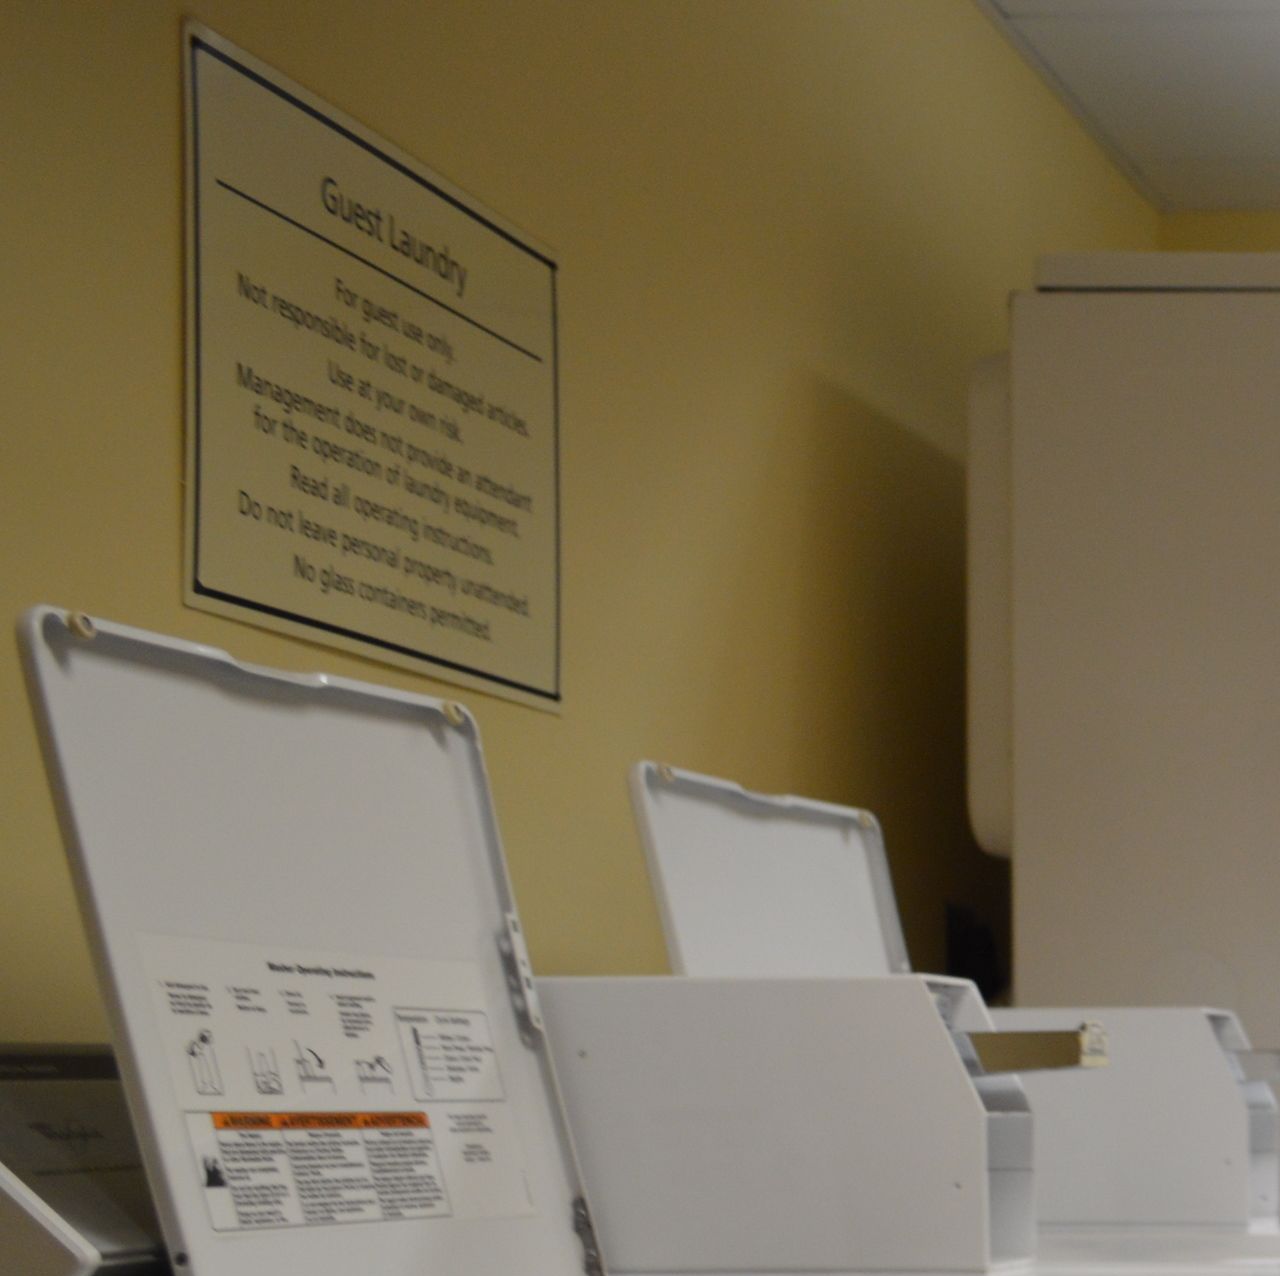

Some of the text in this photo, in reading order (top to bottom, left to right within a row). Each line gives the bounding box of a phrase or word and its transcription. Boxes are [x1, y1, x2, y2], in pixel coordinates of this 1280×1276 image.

[320, 175, 468, 298] Guest Laundry
[237, 271, 268, 309] Not
[271, 292, 356, 352] responsible
[359, 330, 380, 361] for
[384, 343, 408, 378] lost
[410, 363, 425, 383] or
[427, 367, 485, 416] damaged
[335, 277, 359, 309] For
[362, 297, 399, 334] guest
[402, 320, 424, 347] use
[236, 360, 533, 514] Management does not provide an attendant
[327, 357, 354, 393] Use
[357, 378, 374, 402] at
[375, 386, 406, 416] your
[408, 402, 436, 431] own
[254, 402, 278, 437] for
[281, 419, 308, 451] the
[310, 434, 384, 482] operation
[386, 462, 402, 486] of
[403, 465, 450, 515] laundry
[289, 463, 329, 502] Read
[331, 482, 351, 510] all
[353, 495, 420, 543] operating
[238, 488, 264, 521] Do
[265, 504, 295, 535] not
[297, 507, 338, 548] leave
[340, 532, 400, 570] personal
[404, 555, 458, 598] property
[293, 552, 317, 584] No
[319, 563, 355, 595] glass
[358, 582, 428, 621] containers
